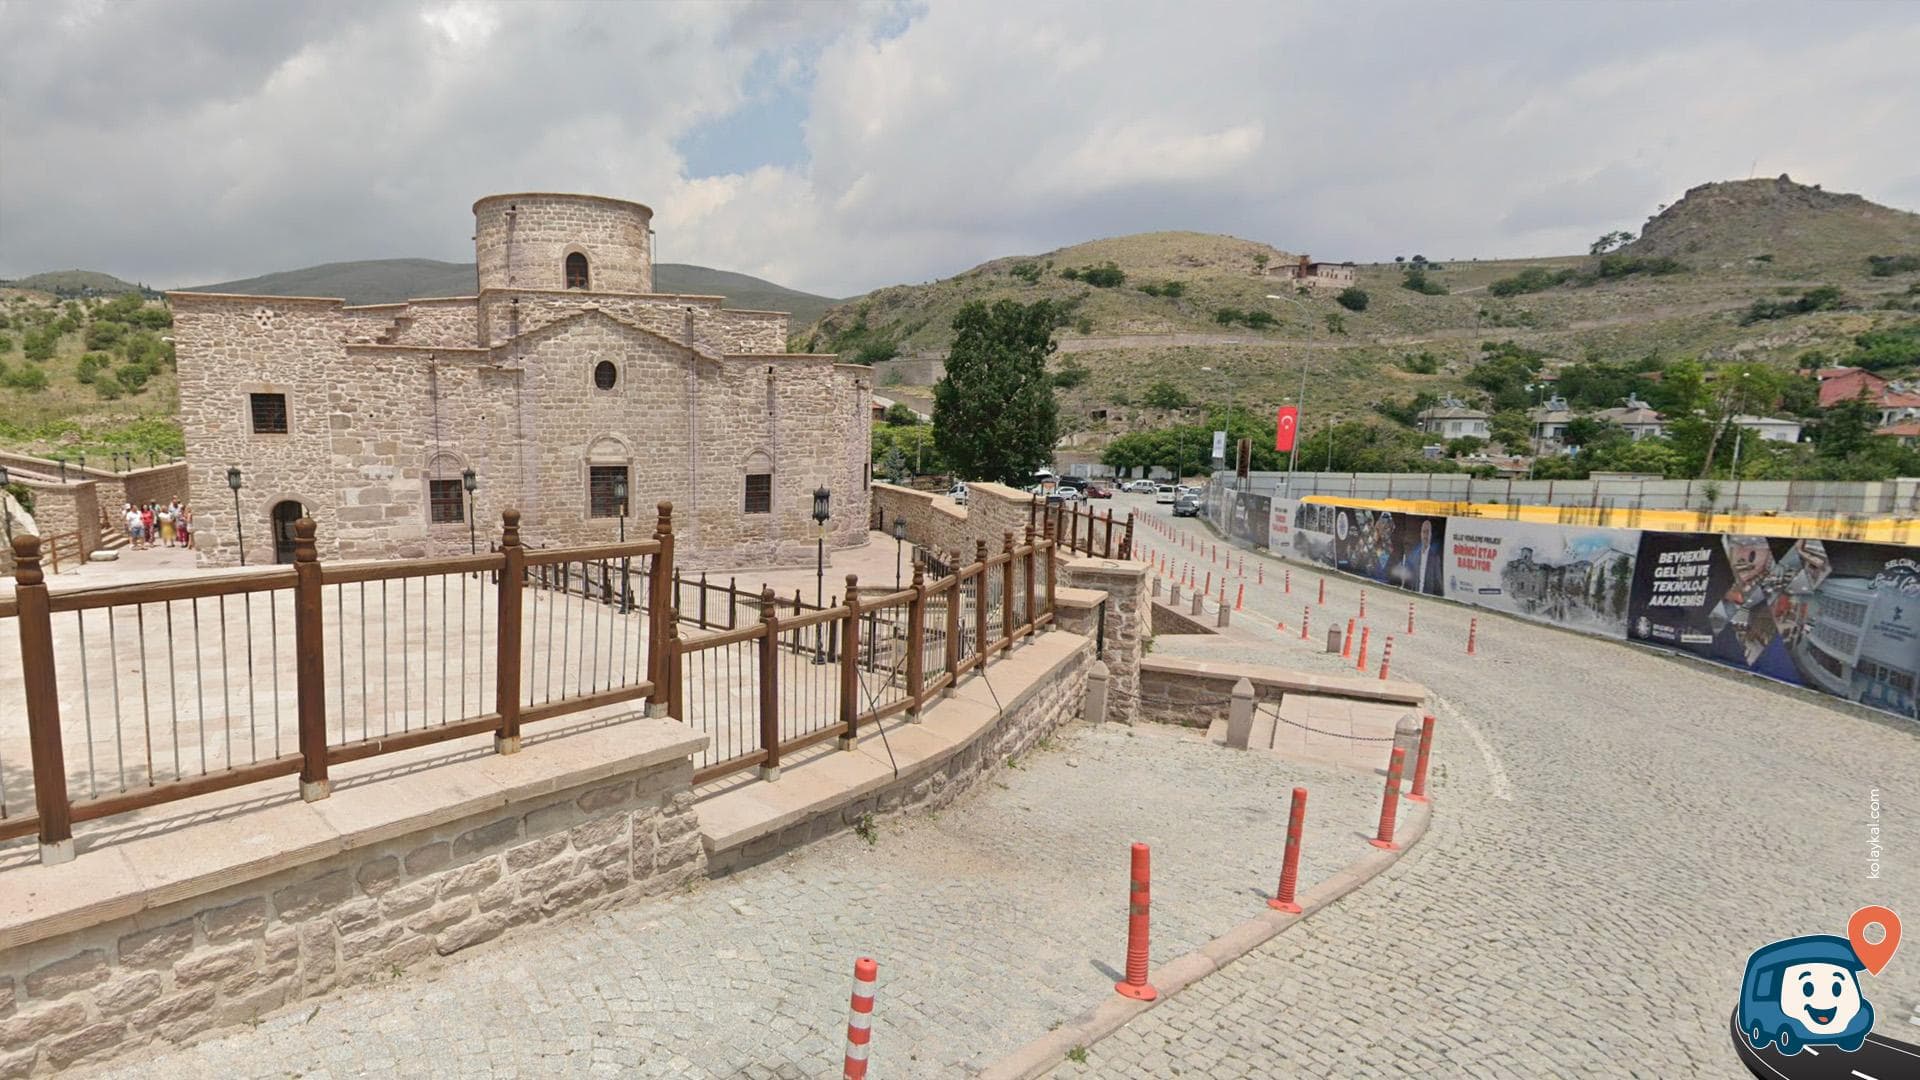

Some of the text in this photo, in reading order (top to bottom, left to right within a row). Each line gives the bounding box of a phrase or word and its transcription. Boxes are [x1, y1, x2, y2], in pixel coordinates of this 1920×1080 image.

[1478, 547, 1497, 560] ETAP
[1659, 547, 1712, 563] BEYHEKİM
[1654, 564, 1710, 579] GELİŞİM VE
[1652, 576, 1709, 592] TEKNOLOJİ
[1648, 592, 1706, 606] AKADEMİSİ
